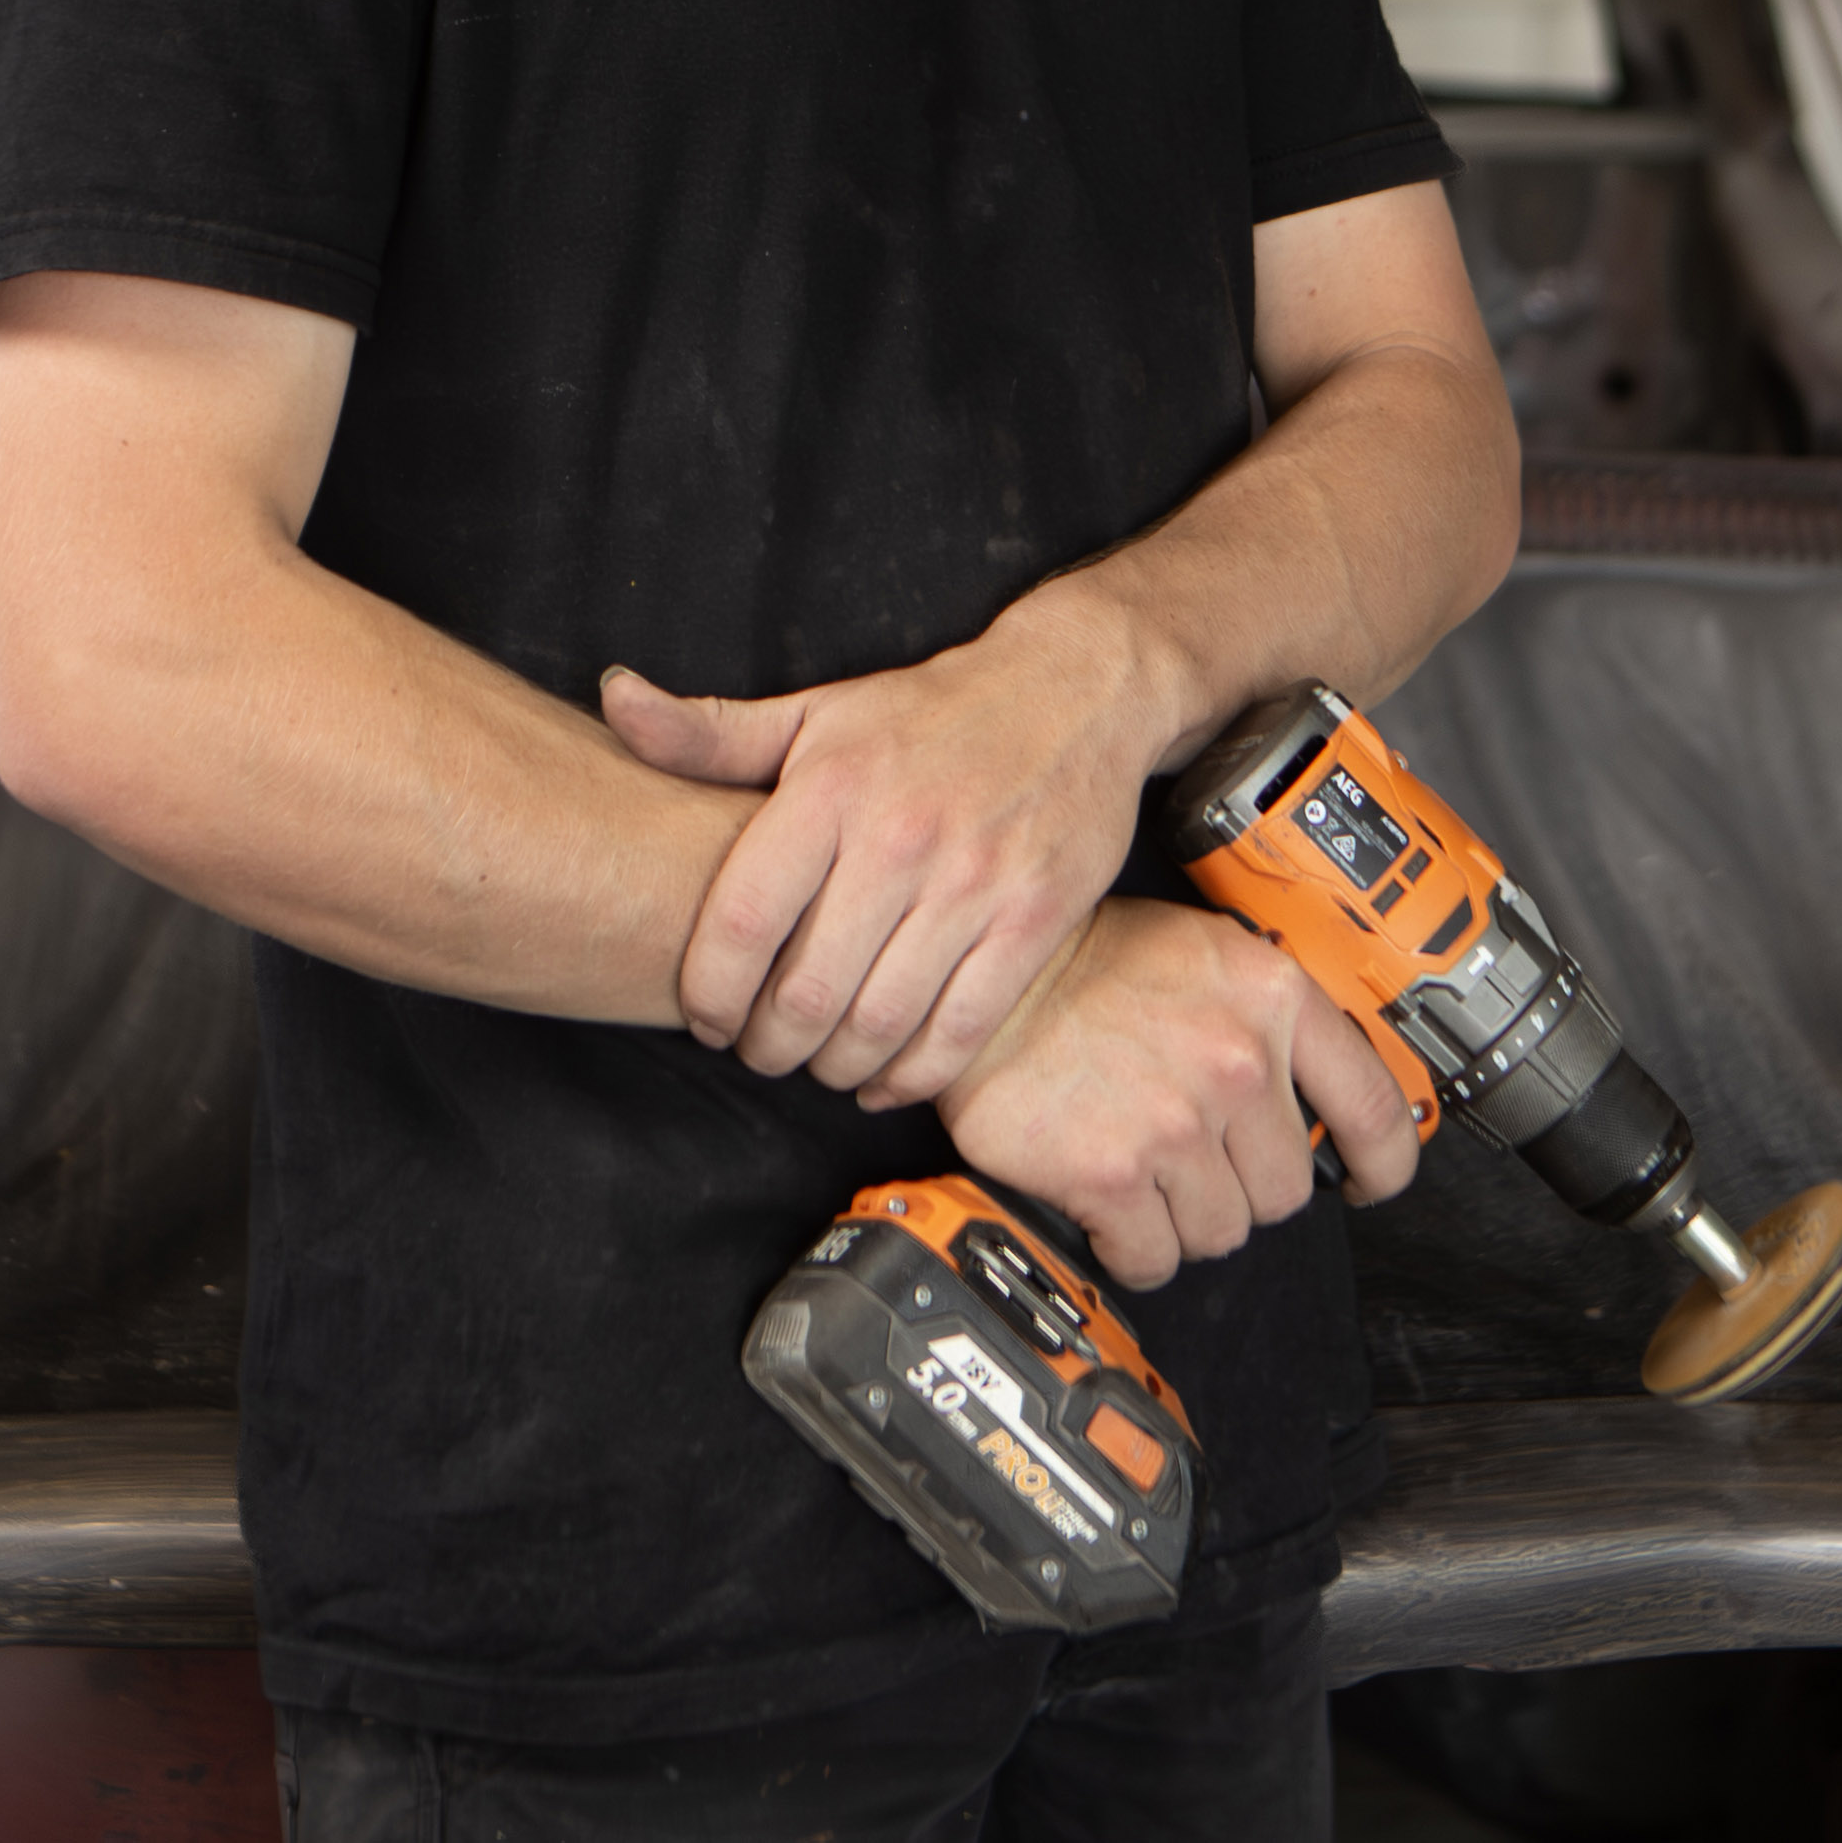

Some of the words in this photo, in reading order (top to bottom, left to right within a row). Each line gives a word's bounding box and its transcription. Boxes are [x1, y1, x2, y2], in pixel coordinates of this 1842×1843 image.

[1330, 770, 1365, 809] AEG
[906, 1357, 968, 1413] 5.0
[976, 1427, 1050, 1498] PRO
